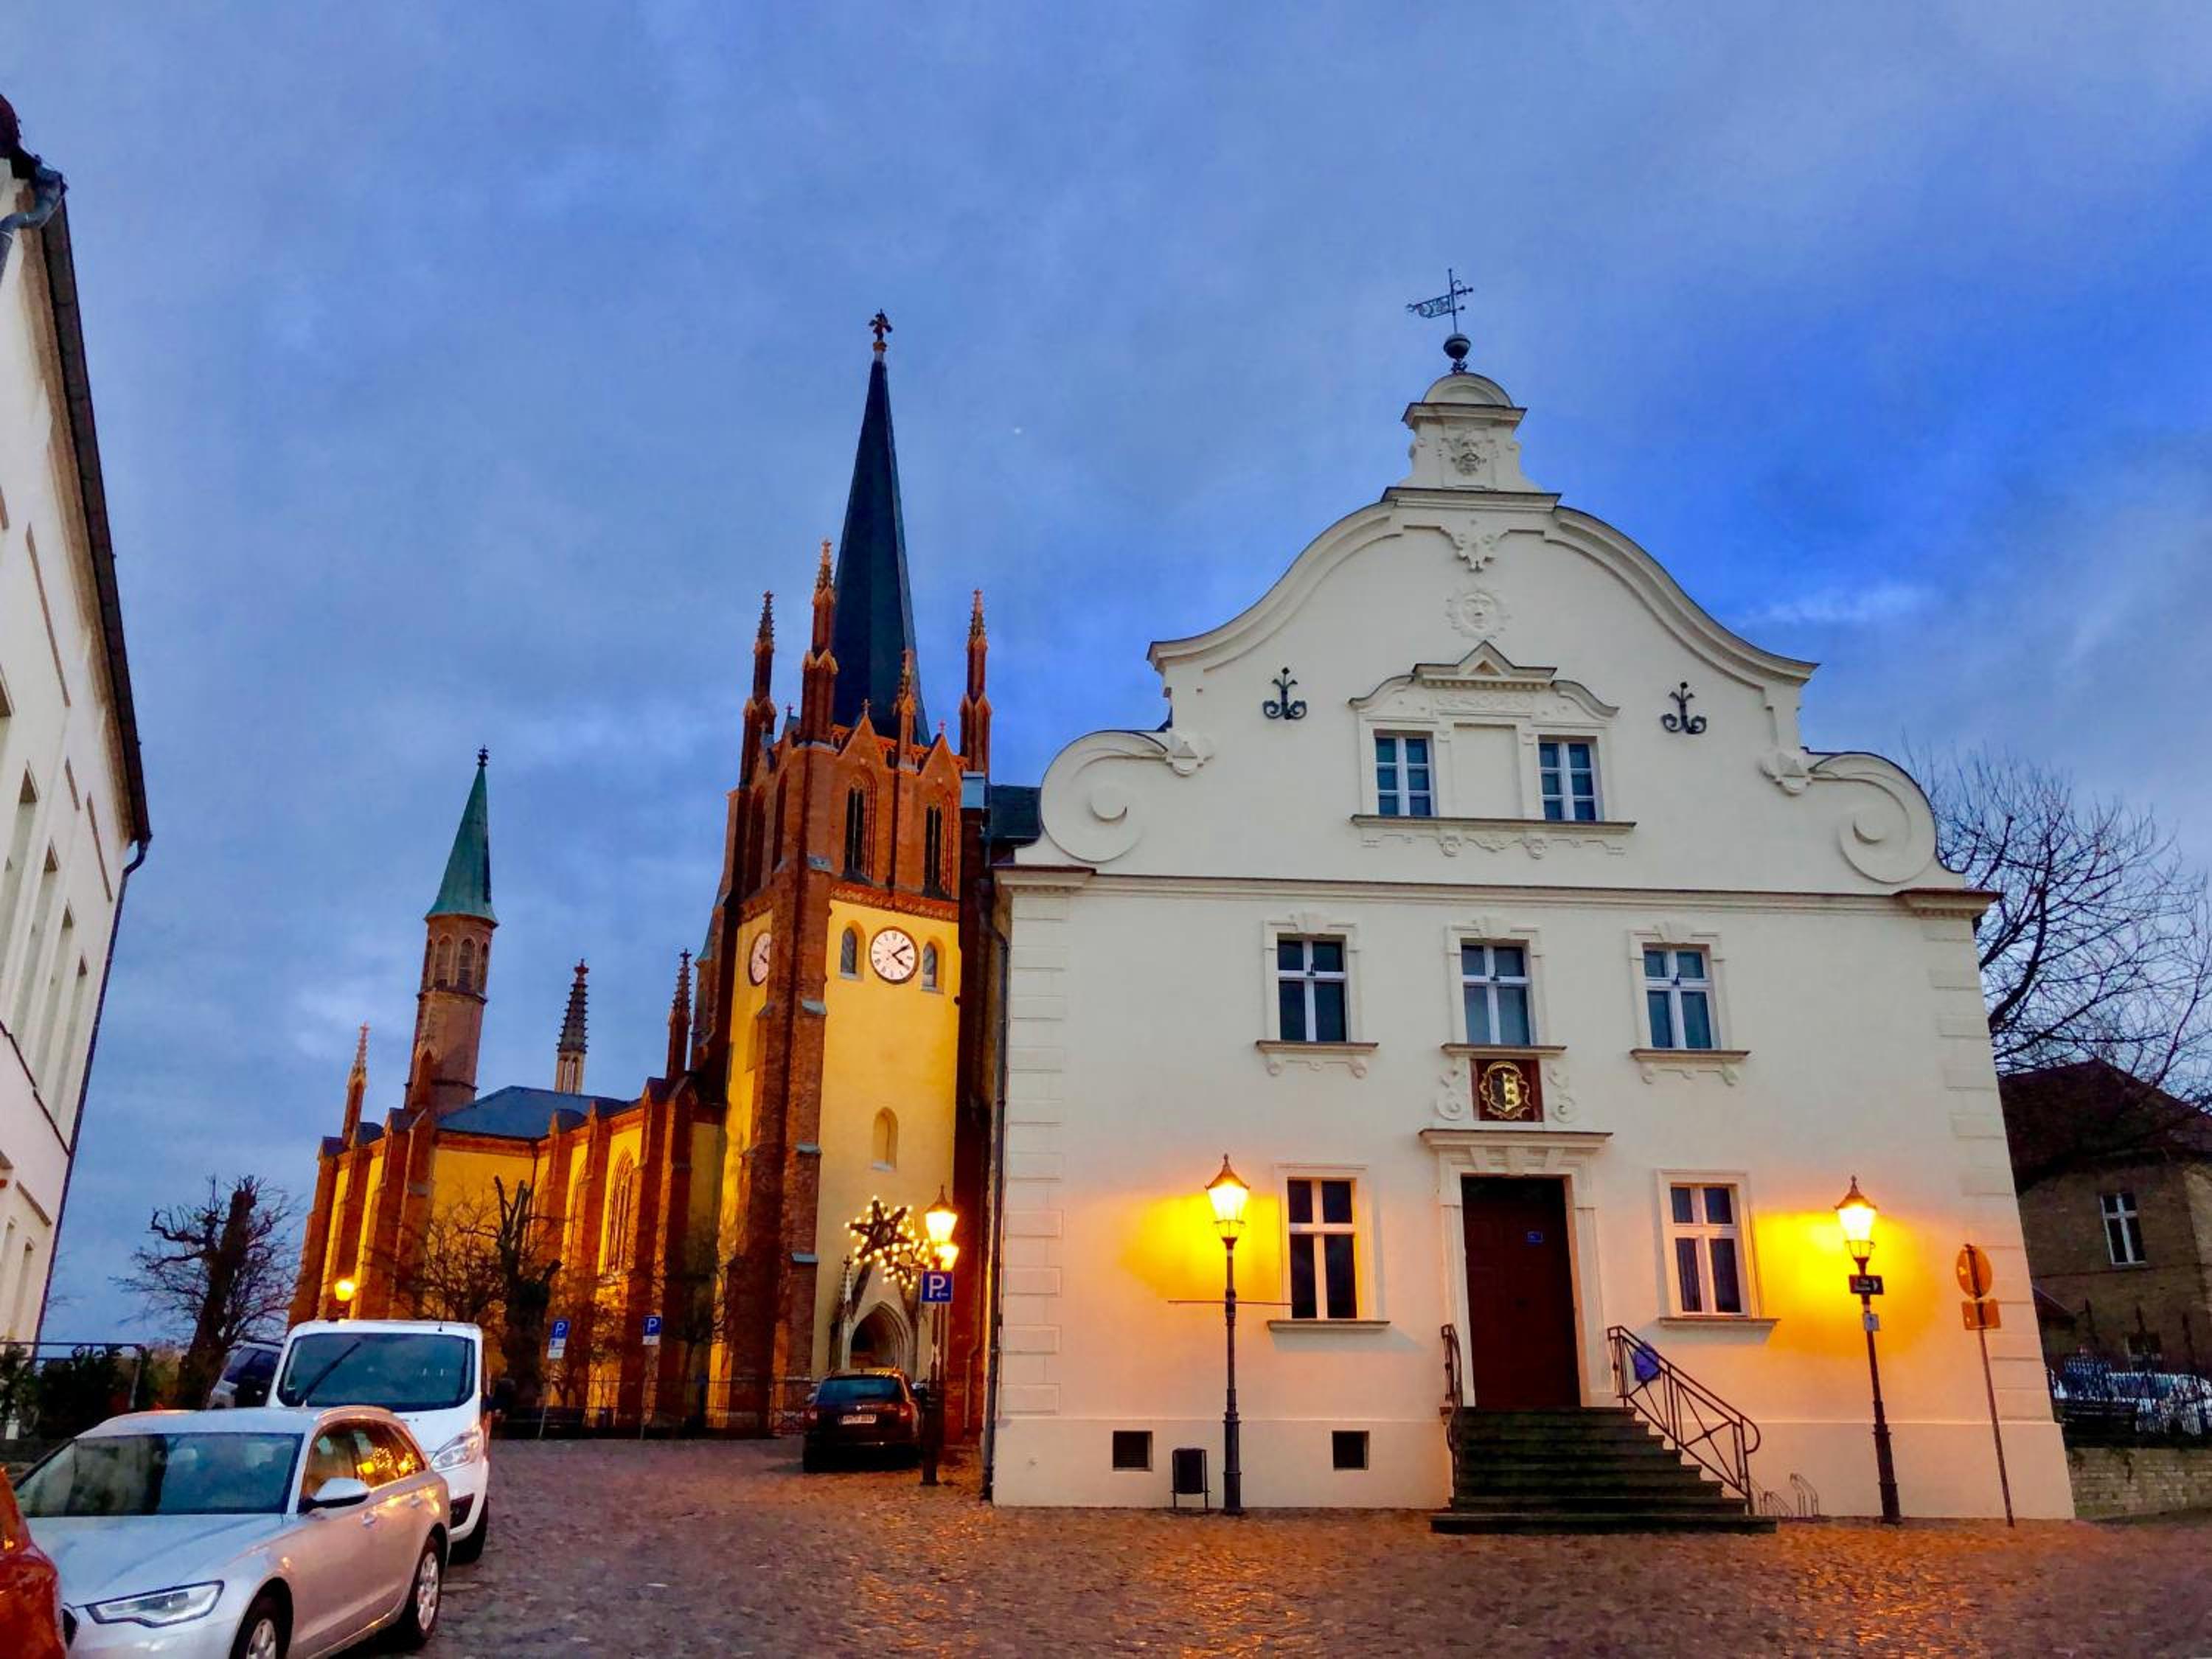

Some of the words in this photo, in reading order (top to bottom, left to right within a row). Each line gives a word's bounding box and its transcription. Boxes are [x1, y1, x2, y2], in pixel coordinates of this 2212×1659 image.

[929, 1275, 945, 1298] P
[556, 1322, 566, 1335] P
[647, 1318, 657, 1332] P
